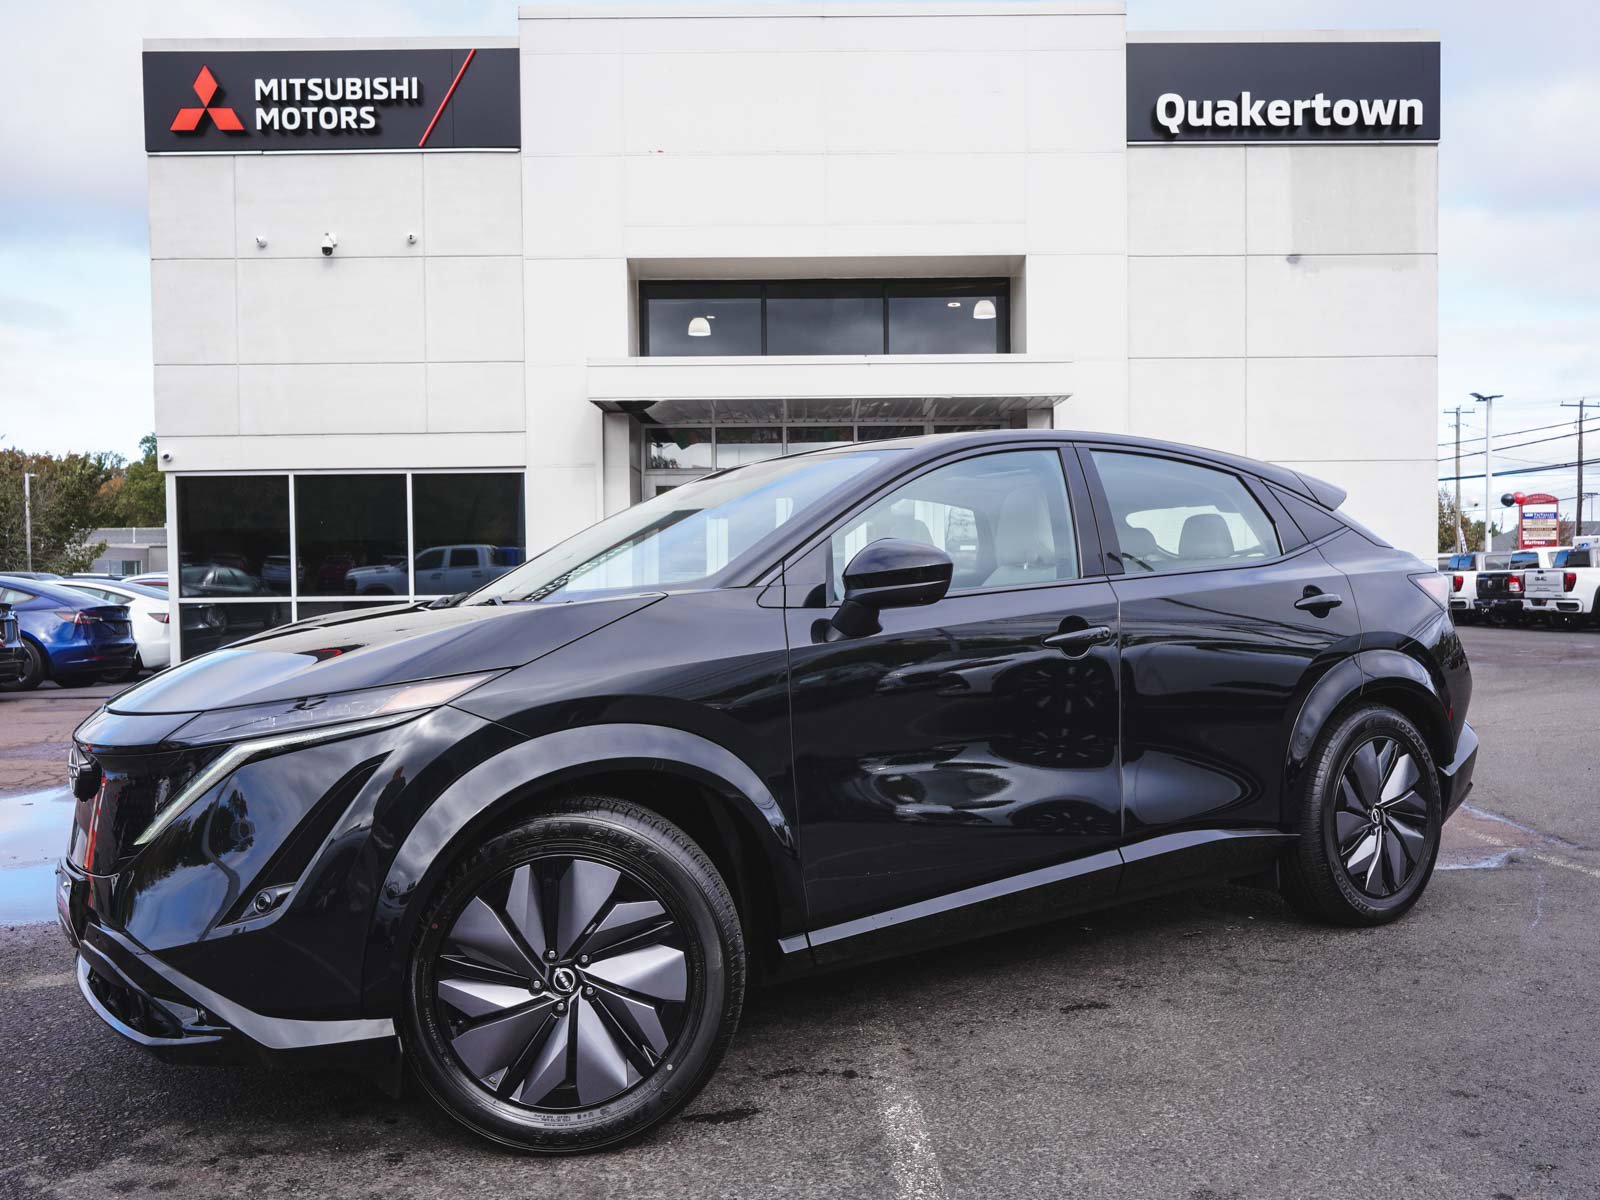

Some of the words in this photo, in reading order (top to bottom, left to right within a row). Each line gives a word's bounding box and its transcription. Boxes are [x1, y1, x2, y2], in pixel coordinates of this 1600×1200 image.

[254, 77, 418, 101] MITSUBISHI
[255, 107, 376, 131] MOTORS
[1156, 91, 1423, 134] Quakertown
